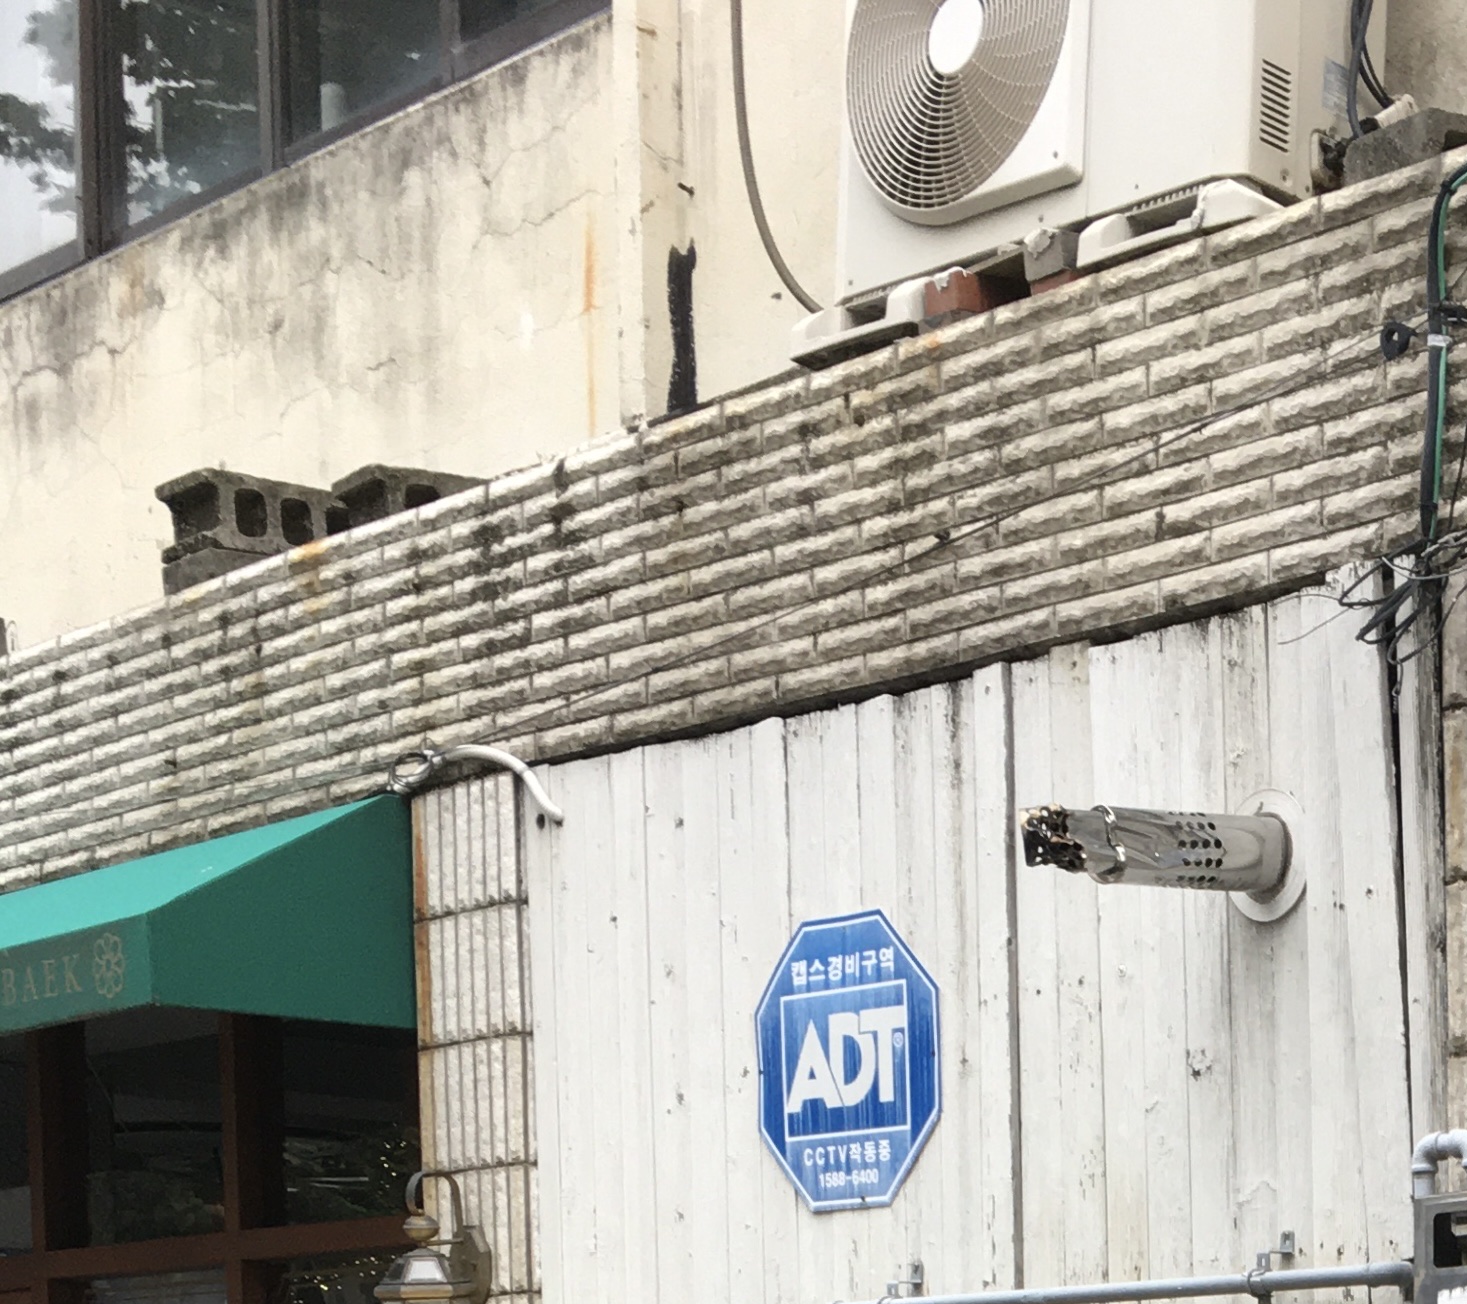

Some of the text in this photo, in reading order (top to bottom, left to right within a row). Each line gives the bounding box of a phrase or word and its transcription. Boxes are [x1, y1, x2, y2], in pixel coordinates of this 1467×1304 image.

[790, 946, 895, 984] 캡스경비구역
[786, 1005, 907, 1114] ADT
[803, 1139, 892, 1168] CCTV작동중
[818, 1169, 880, 1189] 1588-6400
